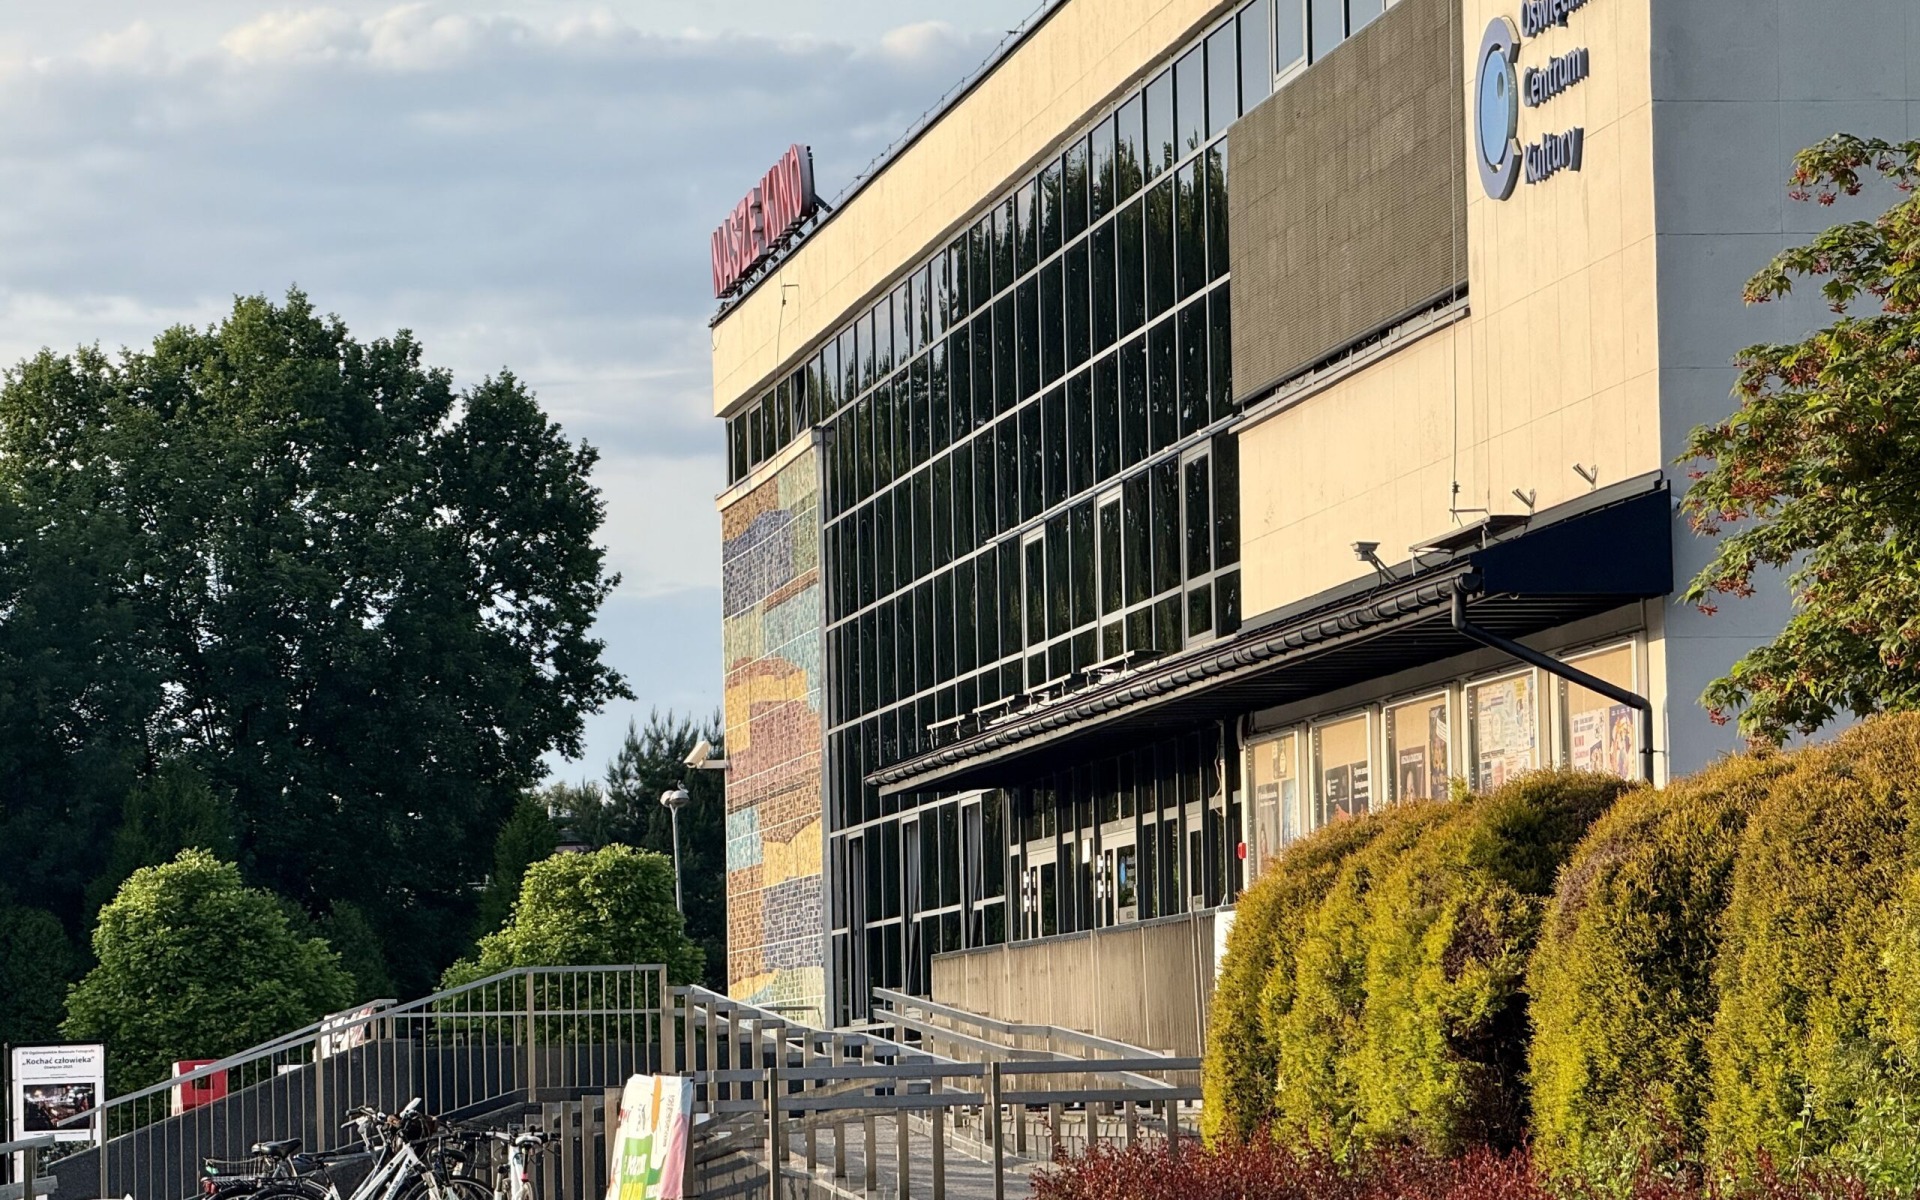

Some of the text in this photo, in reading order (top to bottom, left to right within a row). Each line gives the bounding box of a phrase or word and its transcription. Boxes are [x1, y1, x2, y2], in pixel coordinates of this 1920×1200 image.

[1523, 47, 1589, 108] Centrum
[1524, 126, 1584, 185] Kultury
[711, 143, 809, 299] NASZE KINO
